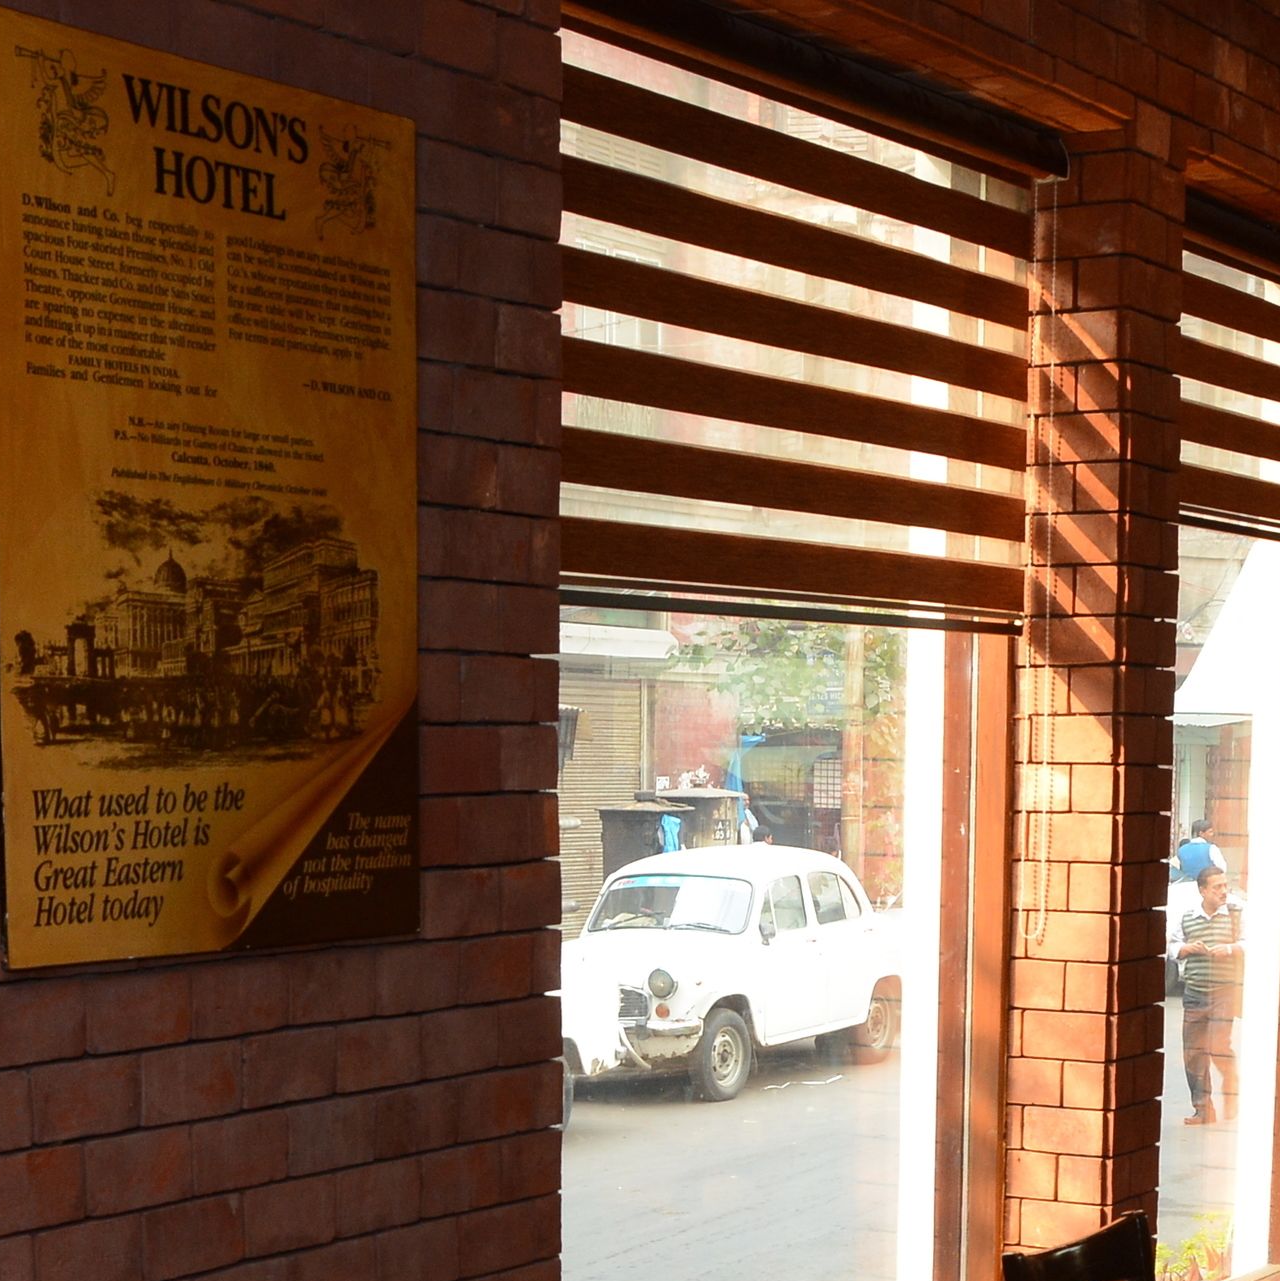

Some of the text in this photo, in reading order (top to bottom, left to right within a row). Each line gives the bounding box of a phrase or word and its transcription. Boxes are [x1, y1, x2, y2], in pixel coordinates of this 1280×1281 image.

[122, 72, 308, 166] WILSON'S
[153, 146, 286, 221] HOTEL
[22, 213, 214, 256] announce having taken those splendid and
[77, 206, 96, 218] and
[127, 214, 142, 230] beg
[205, 229, 214, 241] to
[23, 231, 214, 272] spacious Four-storied Old
[24, 245, 51, 260] Court
[55, 250, 84, 265] House
[119, 261, 157, 282] formerly
[161, 272, 201, 287] occupied
[204, 276, 214, 291] by
[61, 268, 99, 285] Thacker
[101, 277, 117, 288] and
[137, 283, 153, 294] and
[155, 284, 168, 296] the
[171, 287, 189, 300] Sans
[25, 299, 165, 328] are sparing no expense in the
[67, 289, 106, 303] opposite
[109, 293, 165, 312] Government
[200, 309, 215, 320] and
[25, 315, 216, 351] and fitting it up in a manner that will render
[25, 330, 165, 360] it one of the most comfortable
[271, 337, 285, 347] and
[27, 362, 217, 397] Families and Gentlemen looking out for
[69, 353, 150, 374] FAMILY HOTELS IN
[321, 382, 375, 399] WILSON AND
[32, 783, 245, 819] What used to be the
[33, 818, 210, 855] Wilson's Hotel is
[348, 812, 411, 830] The name
[326, 829, 408, 852] has changed
[34, 854, 184, 891] Great Eastern
[304, 851, 411, 872] not the tradition
[284, 872, 373, 900] of hospitality
[34, 889, 164, 929] Hotel today
